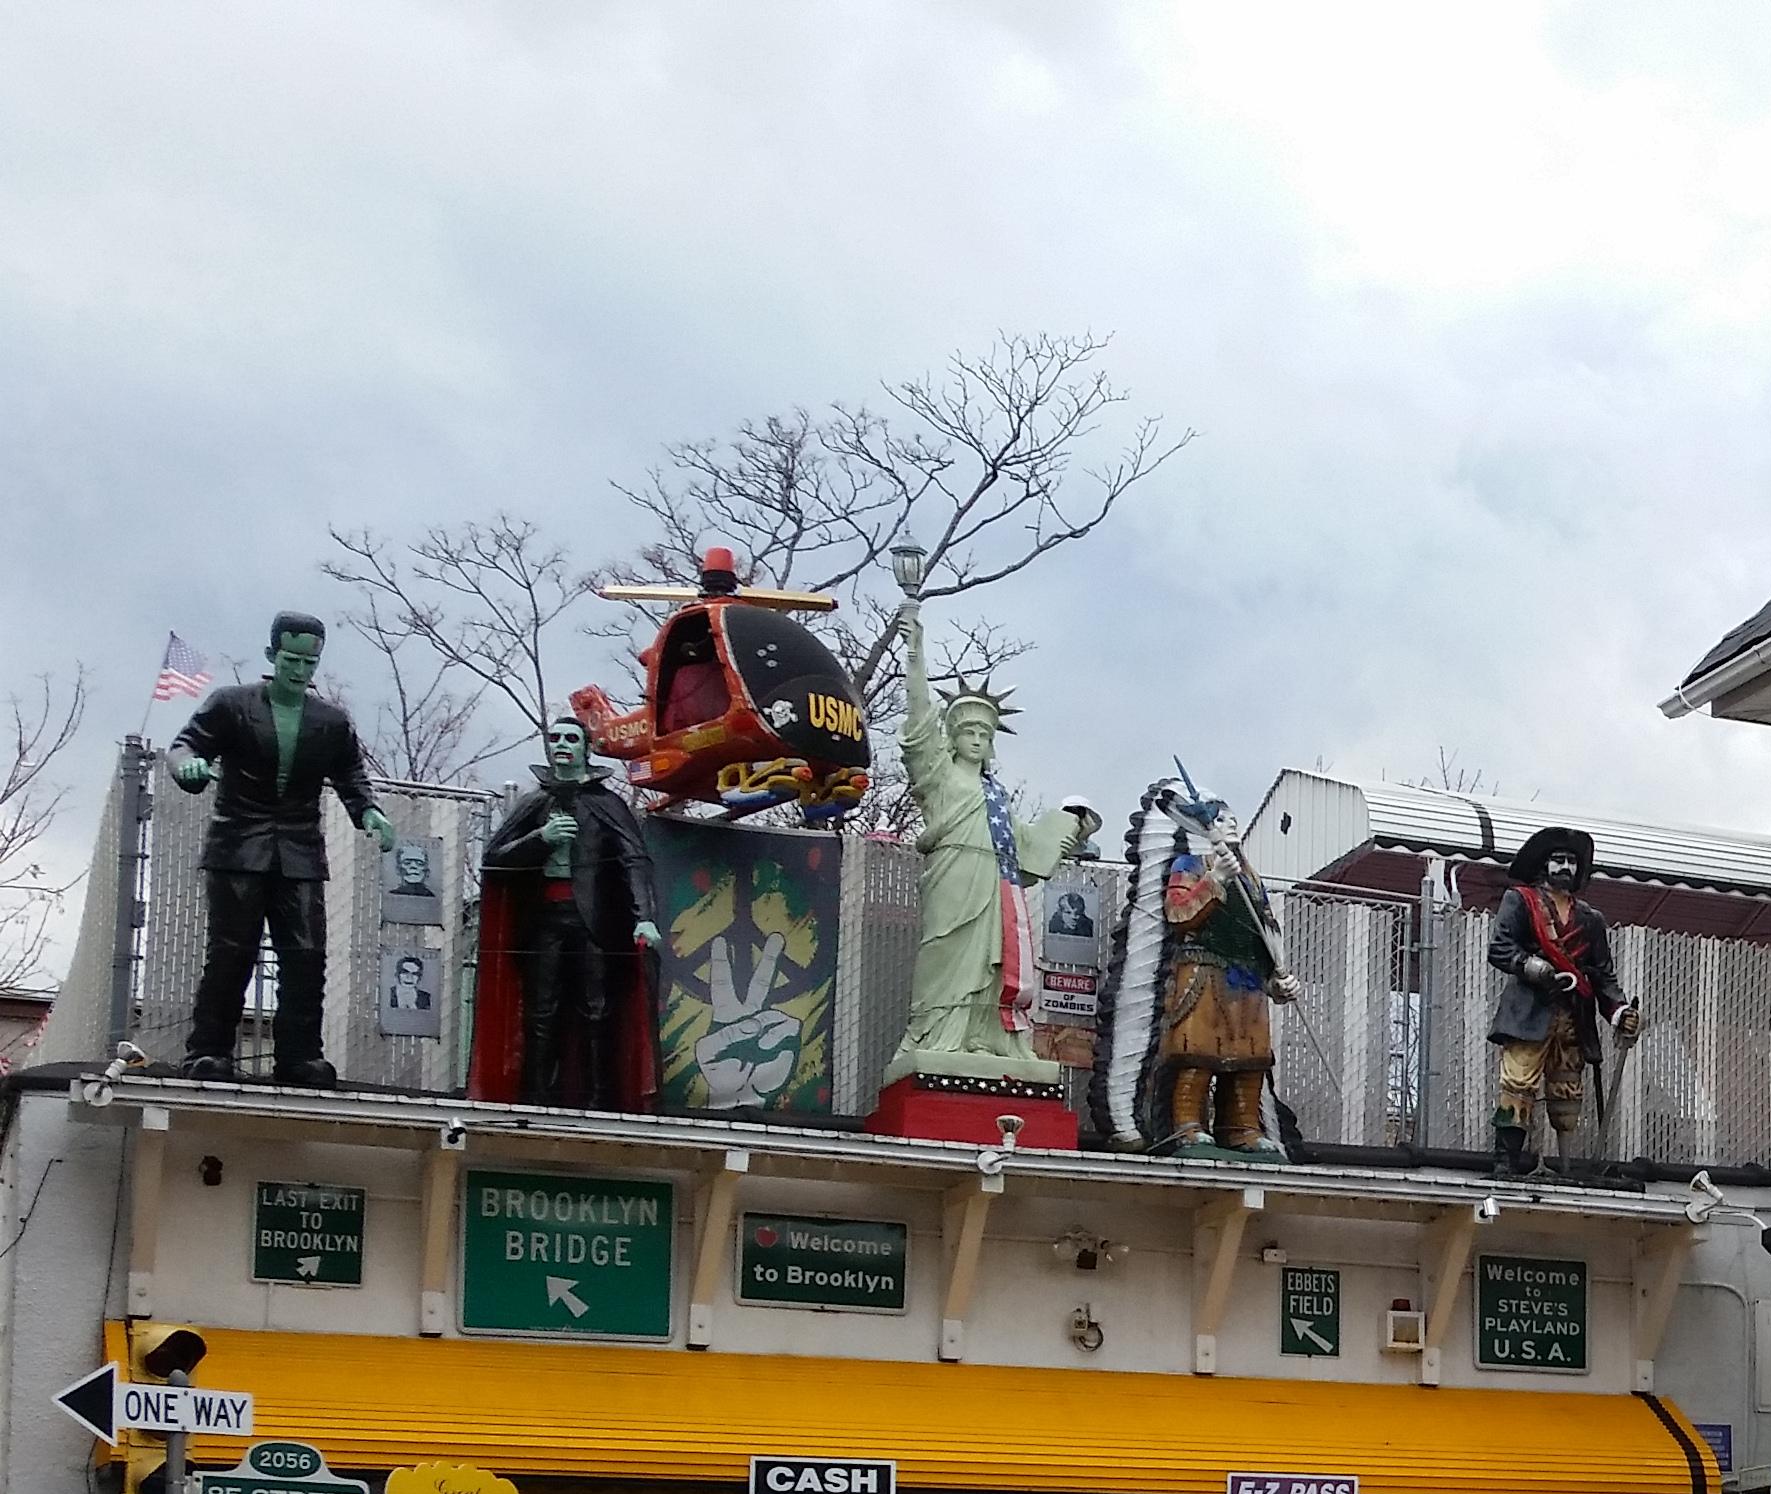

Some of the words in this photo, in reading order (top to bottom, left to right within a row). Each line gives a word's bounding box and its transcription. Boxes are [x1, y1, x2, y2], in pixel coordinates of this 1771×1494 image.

[808, 692, 863, 741] USMC
[608, 719, 648, 742] USMC
[1050, 975, 1090, 991] BEWARE
[1044, 999, 1094, 1012] ZOMBIES
[262, 1188, 307, 1208] LAST
[320, 1193, 359, 1211] EXIT
[481, 1187, 657, 1226] BROOKLYN
[300, 1212, 322, 1229] TO
[261, 1229, 358, 1252] BROOKLYN
[505, 1230, 632, 1266] BRIDGE
[790, 1231, 892, 1256] Welcome
[753, 1263, 779, 1282] to
[787, 1265, 894, 1293] Brooklyn
[1287, 1272, 1335, 1294] EBBETS
[1487, 1264, 1580, 1286] Welcome
[1525, 1286, 1541, 1297] to
[1290, 1294, 1333, 1316] FIELD
[1498, 1299, 1568, 1317] STEVE'S
[1484, 1317, 1580, 1336] PLAYLAND
[124, 1390, 178, 1424] ONE
[193, 1396, 247, 1429] WAY
[259, 1451, 311, 1470] 2056
[765, 1465, 878, 1494] CASH
